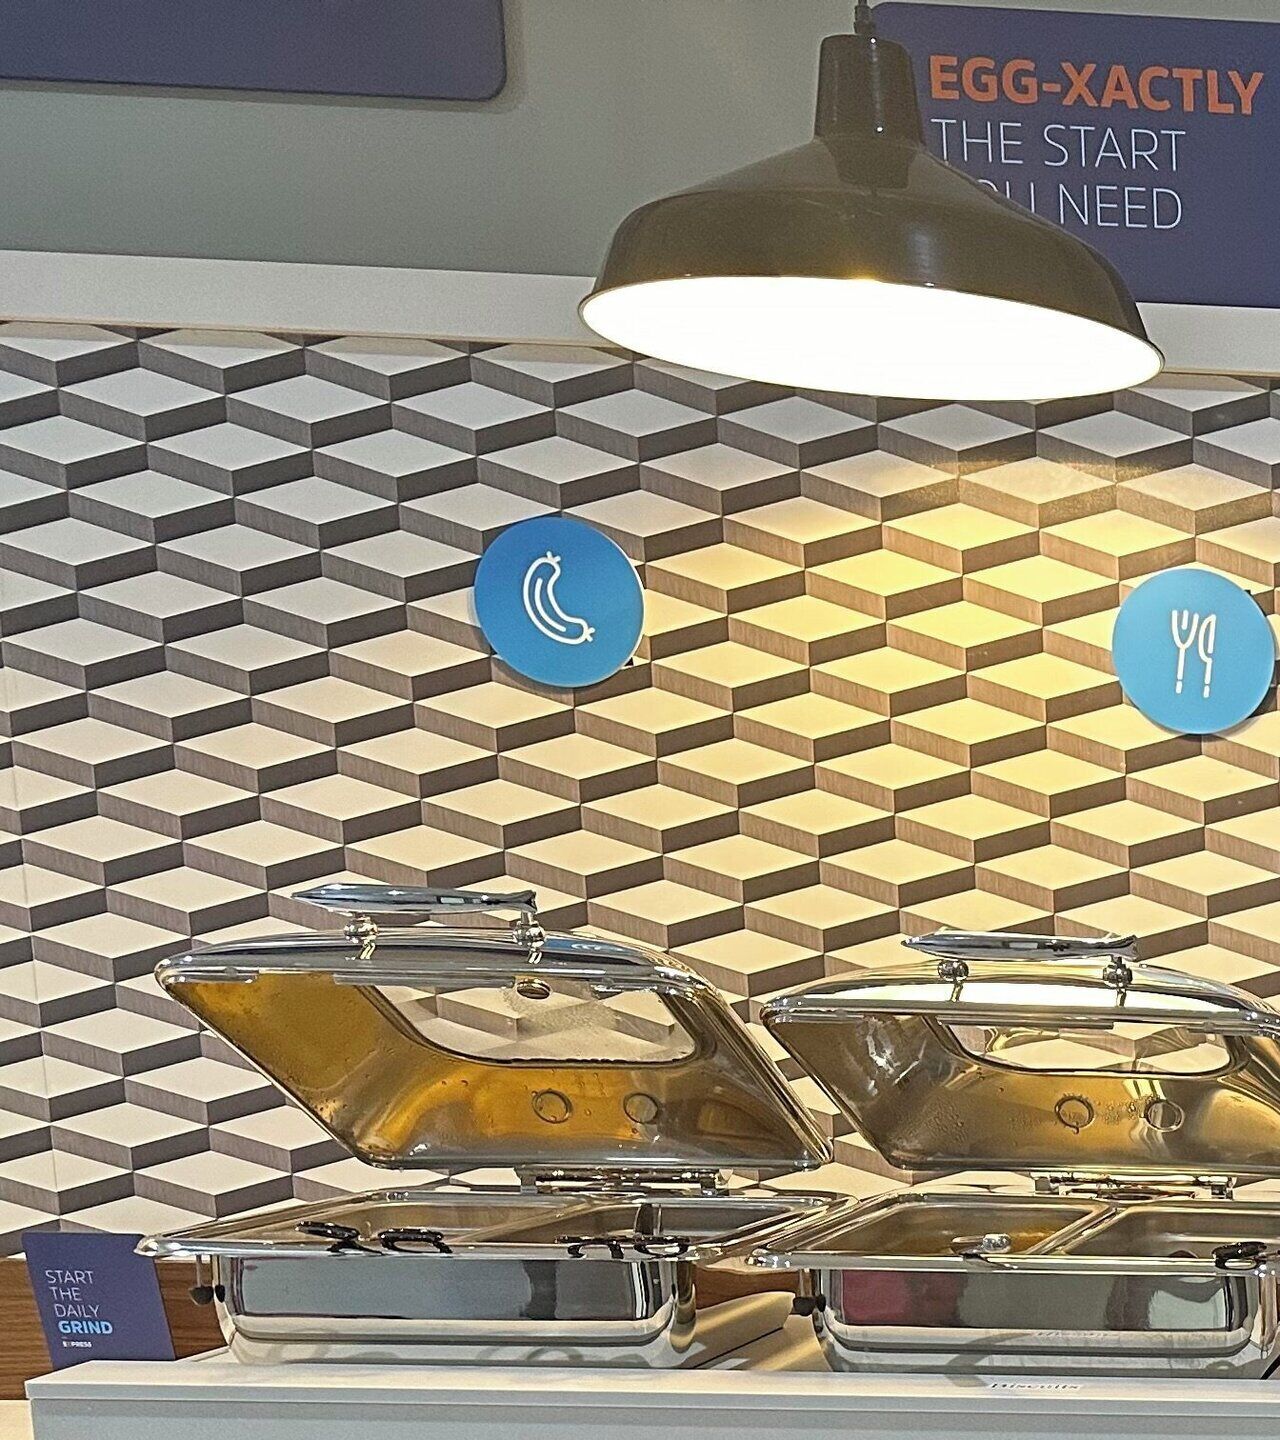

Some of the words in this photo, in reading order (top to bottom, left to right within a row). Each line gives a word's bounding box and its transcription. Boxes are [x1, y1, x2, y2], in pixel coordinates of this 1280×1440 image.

[929, 54, 1265, 115] EGG-XACTLY
[930, 118, 1023, 165] THE
[1043, 123, 1186, 171] START
[1059, 183, 1183, 229] NEED
[45, 1270, 94, 1285] START
[51, 1286, 83, 1302] THE
[54, 1304, 100, 1319] DAILY
[58, 1320, 114, 1335] GRIND
